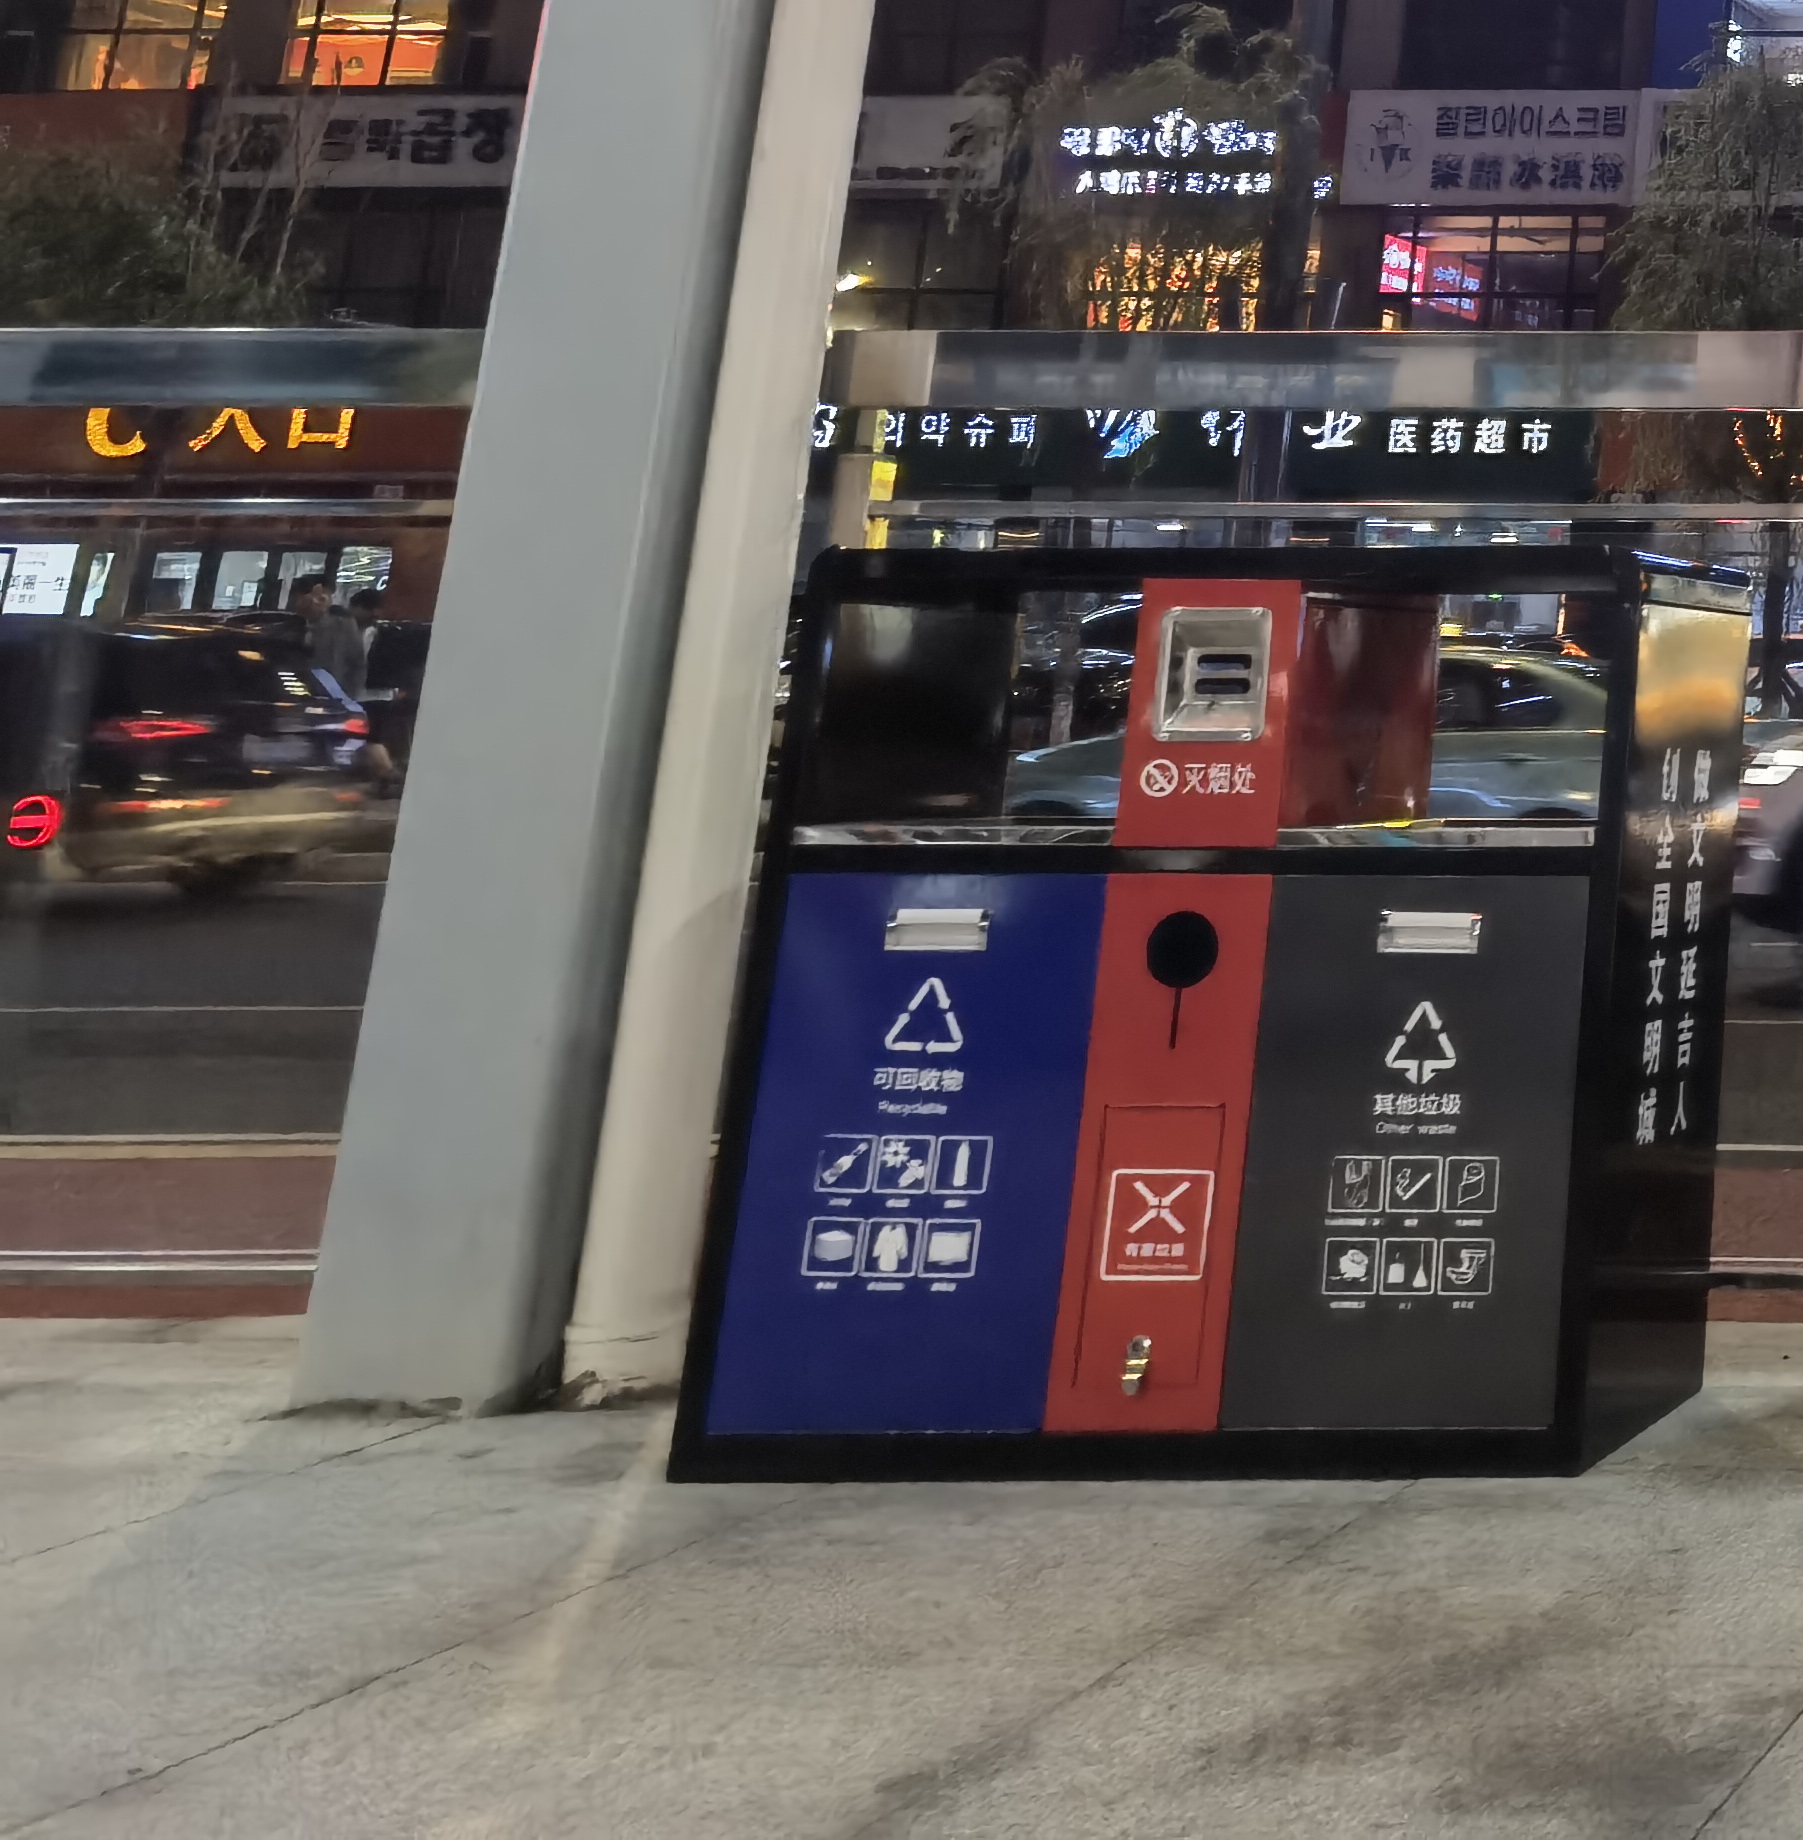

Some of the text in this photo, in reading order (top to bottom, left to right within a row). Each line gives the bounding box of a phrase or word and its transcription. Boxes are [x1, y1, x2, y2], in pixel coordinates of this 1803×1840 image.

[1387, 418, 1552, 455] 医药超市
[1182, 763, 1256, 795] 灭烟处
[873, 1067, 965, 1092] 可回收物
[1373, 1093, 1461, 1115] 其他垃圾
